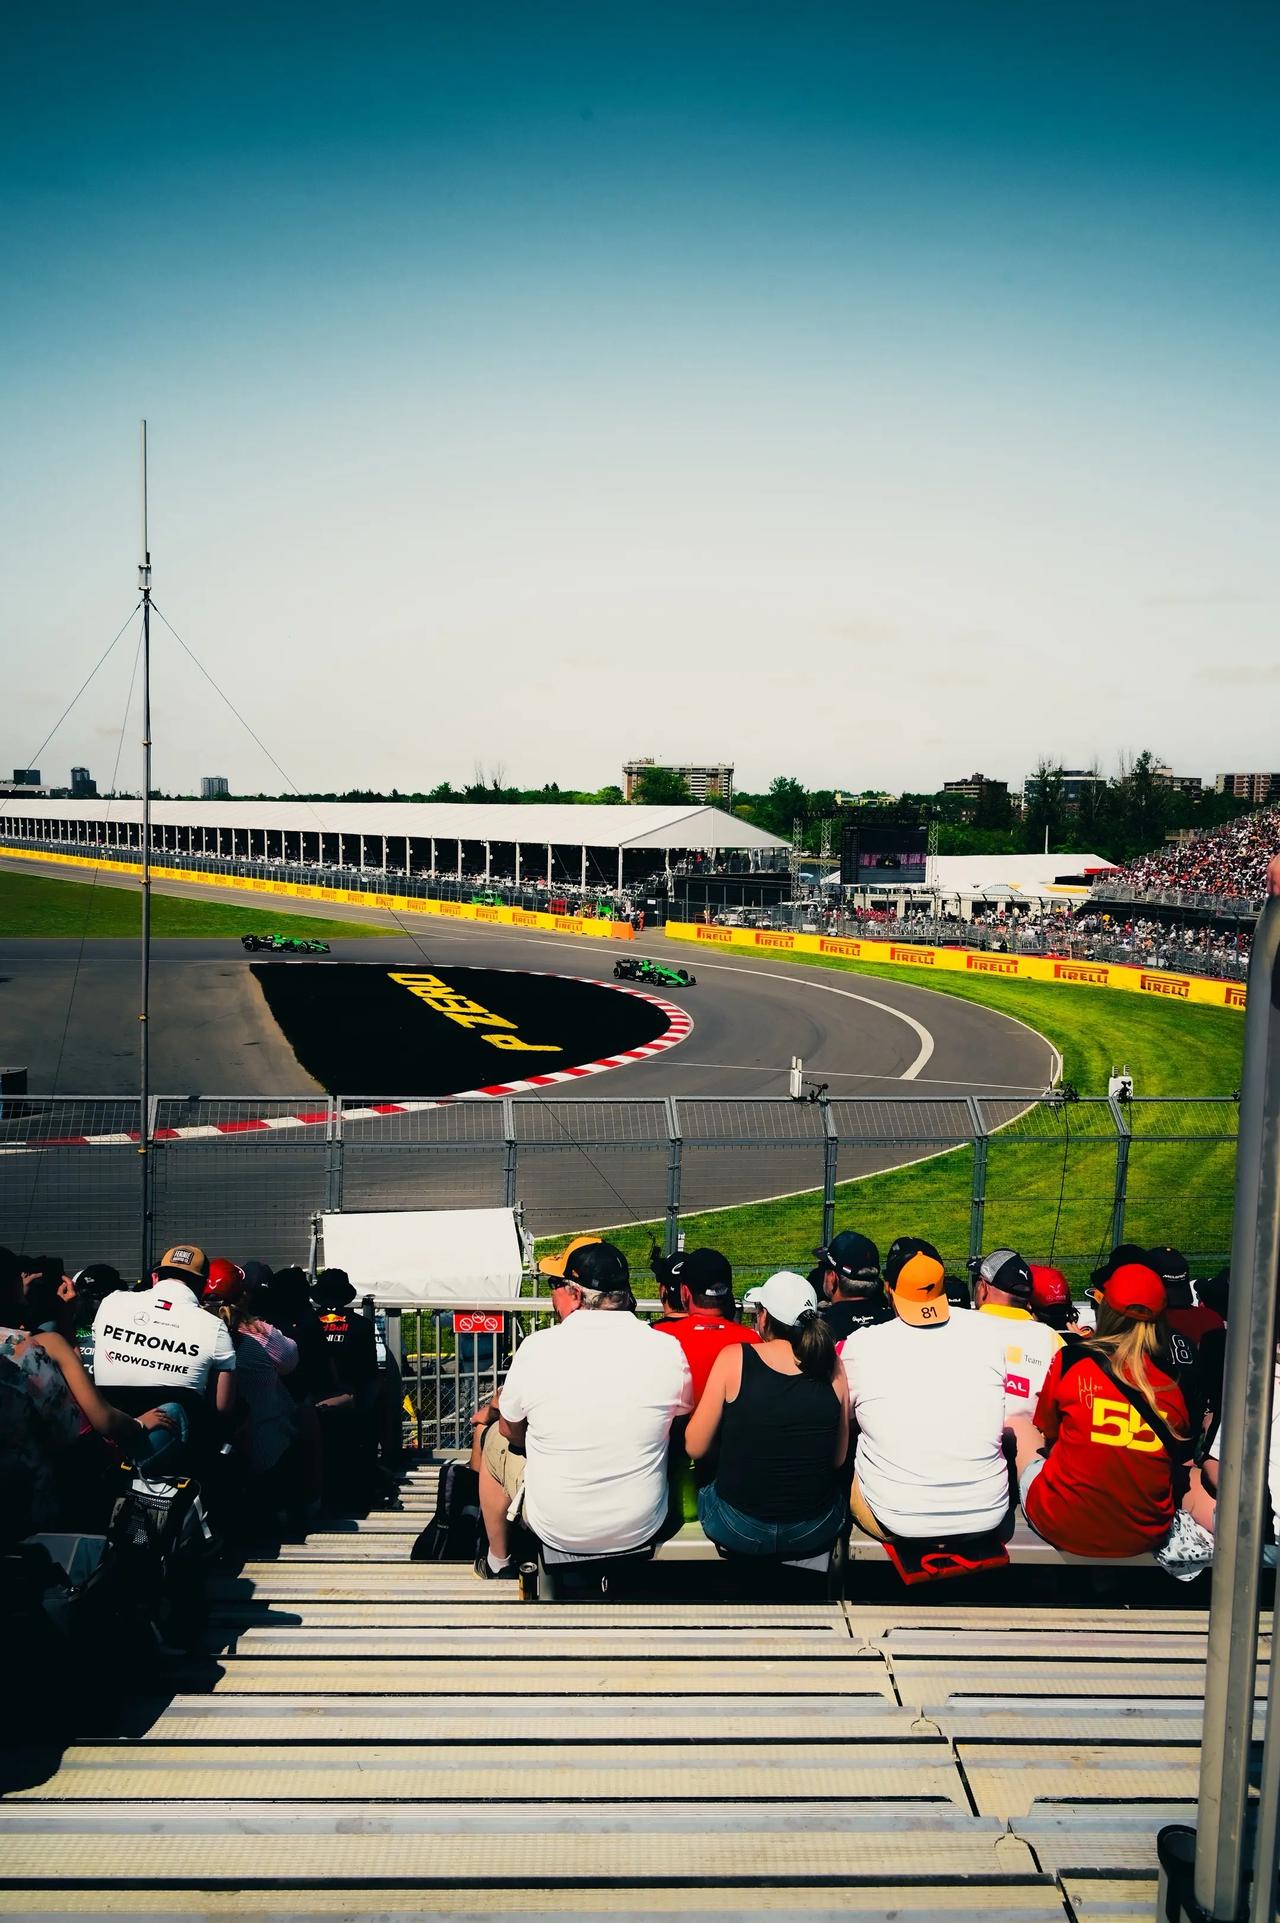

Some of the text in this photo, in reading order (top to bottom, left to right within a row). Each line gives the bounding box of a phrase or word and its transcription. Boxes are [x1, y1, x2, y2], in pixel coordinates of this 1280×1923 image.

[512, 912, 537, 925] PIRELLI
[555, 917, 583, 931] PIRELLI
[697, 927, 732, 942] PIRELLI
[755, 933, 795, 948] PIRELLI
[819, 939, 861, 956] PIRELLI
[890, 947, 935, 965] PIRELLI
[966, 955, 1019, 973] PIRELLI
[1054, 964, 1109, 984] PIRELLI
[1140, 974, 1190, 997] PIRELLI
[387, 973, 564, 1051] P ZERO
[921, 1306, 938, 1319] 81
[103, 1324, 200, 1357] PETRONAS
[108, 1351, 190, 1375] CROWDSTRIKE
[1024, 1354, 1043, 1367] Team
[1090, 1397, 1169, 1453] 55
